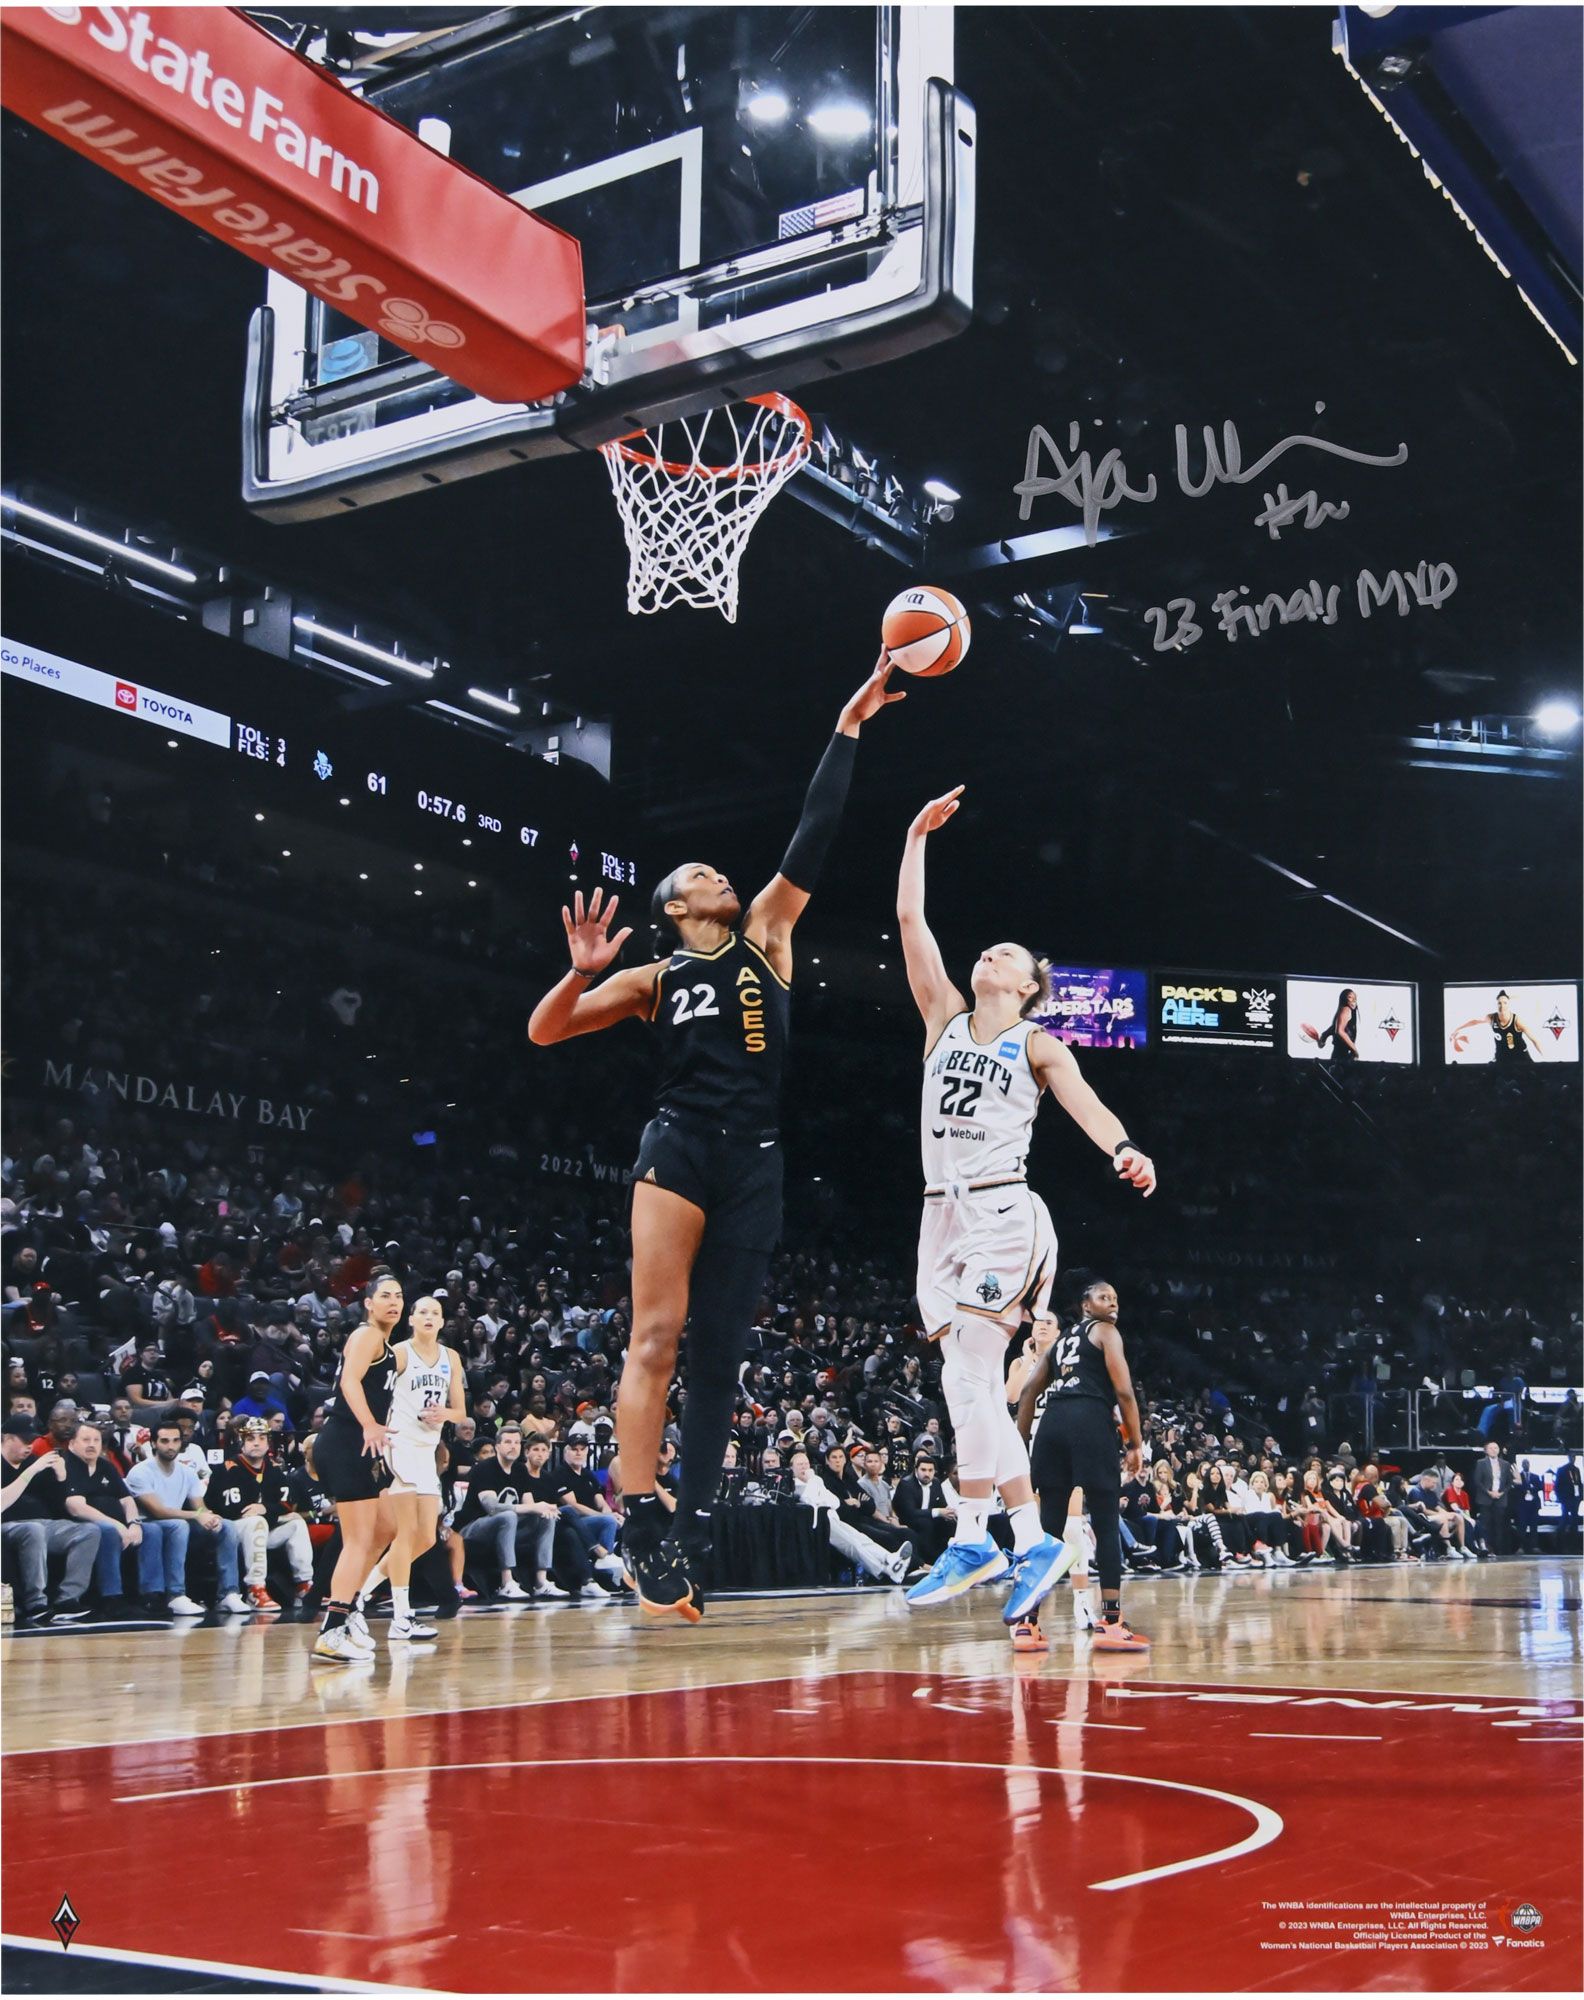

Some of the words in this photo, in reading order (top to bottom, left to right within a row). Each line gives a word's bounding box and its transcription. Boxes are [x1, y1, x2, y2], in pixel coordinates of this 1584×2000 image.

[1, 649, 18, 664] Go
[22, 656, 61, 679] Places
[142, 697, 193, 724] TOYOTA
[237, 723, 270, 747] TOL:
[278, 738, 286, 753] 3
[238, 738, 270, 761] FLS:
[277, 753, 286, 767] 4
[367, 772, 386, 795] 61
[417, 791, 466, 822] 0:57.6
[478, 814, 502, 833] 3RD
[520, 827, 539, 846] 67
[601, 852, 625, 871] TOL:
[629, 862, 635, 873] 3
[602, 865, 625, 882] FLS:
[629, 874, 636, 886] 4
[671, 983, 719, 1025] 22
[1161, 985, 1238, 1003] PACK'S
[1163, 998, 1205, 1013] ALL
[736, 966, 767, 1053] ACES
[1161, 1009, 1219, 1027] HERE
[43, 1059, 246, 1119] MANDALAY
[257, 1099, 314, 1131] BAY
[939, 1076, 983, 1117] 22
[950, 1127, 986, 1141] Webull
[540, 1153, 583, 1177] 2022
[593, 1163, 634, 1184] WNB
[1056, 1336, 1080, 1366] 12
[42, 1379, 54, 1389] 12
[213, 1452, 218, 1460] 5
[253, 1521, 265, 1577] ACES
